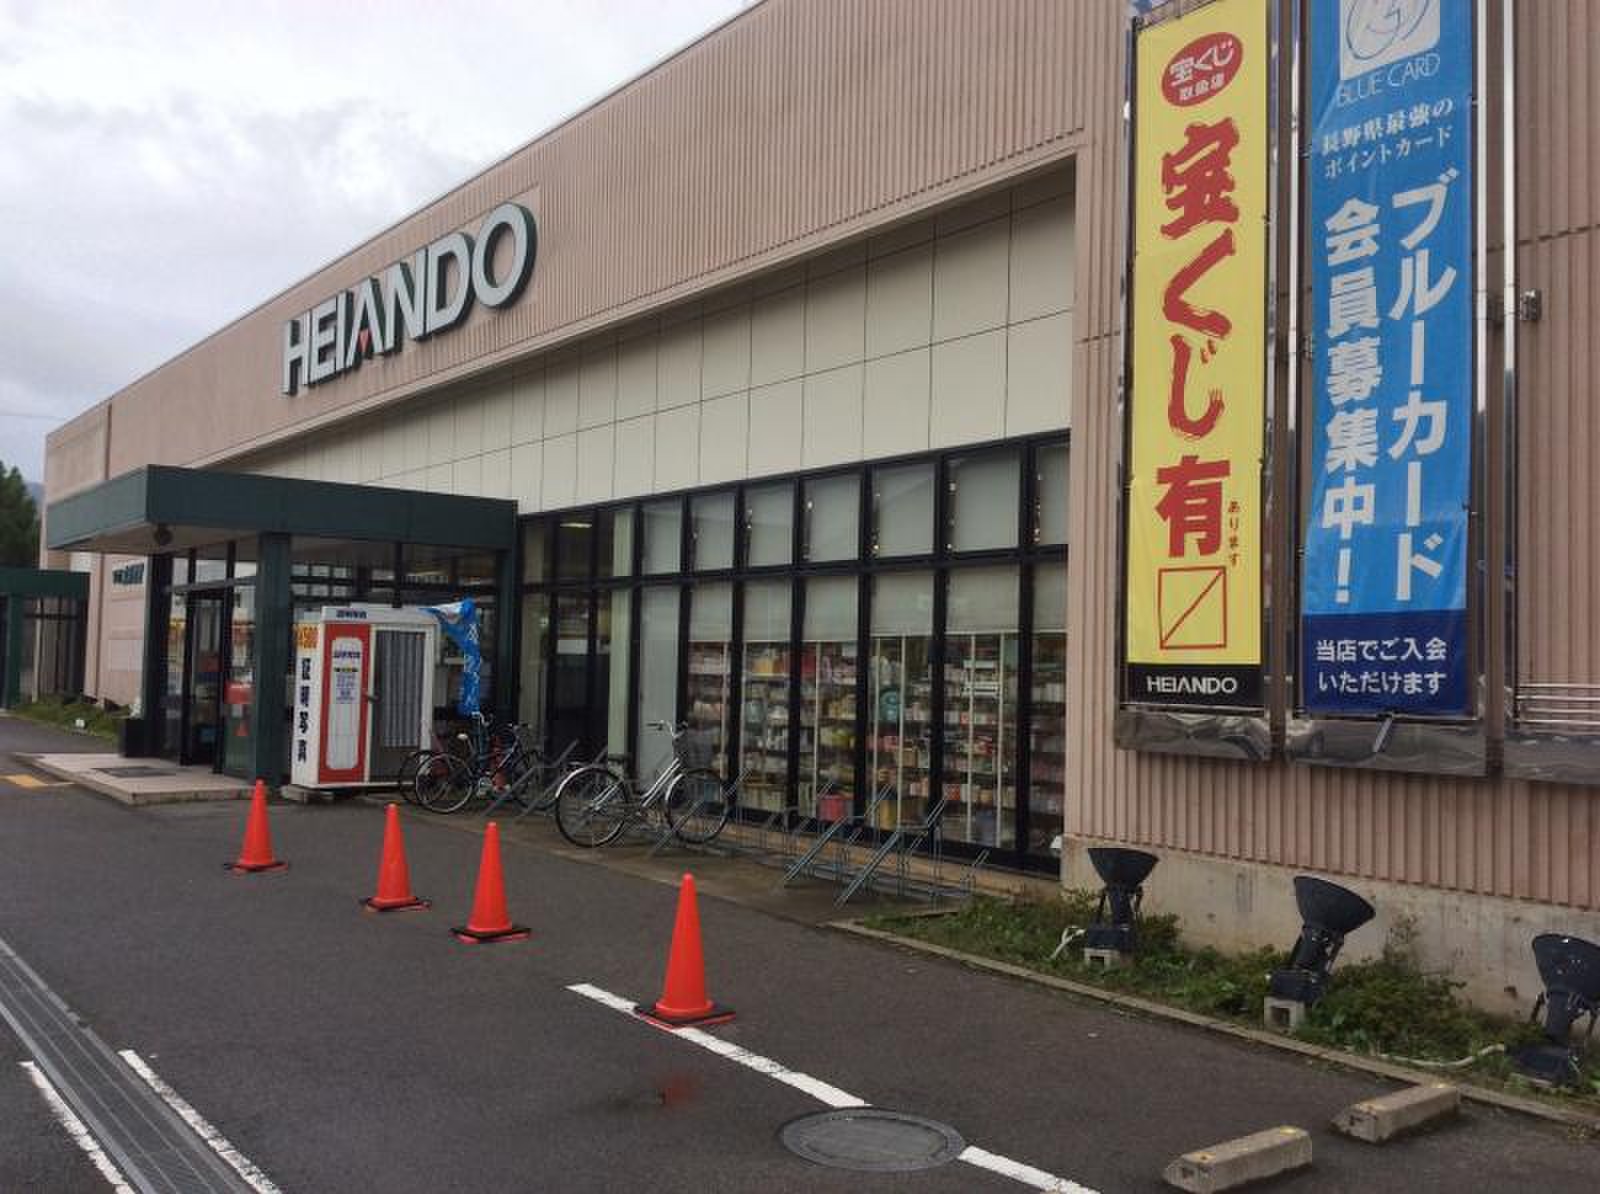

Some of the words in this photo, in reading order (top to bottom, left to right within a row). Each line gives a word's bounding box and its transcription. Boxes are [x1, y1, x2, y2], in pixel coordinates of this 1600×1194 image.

[1170, 39, 1234, 86] 宝くじ
[1335, 71, 1383, 107] BLUE
[1388, 53, 1441, 87] CARD
[1324, 125, 1453, 178] ポイントカード
[280, 201, 537, 395] HEIANDO
[1321, 197, 1383, 604] 会員募集中!
[1388, 168, 1459, 600] ブルーカード
[1316, 636, 1447, 662] 当店でご入会
[1146, 676, 1238, 694] HEIANDO
[1318, 670, 1447, 694] いただけます
